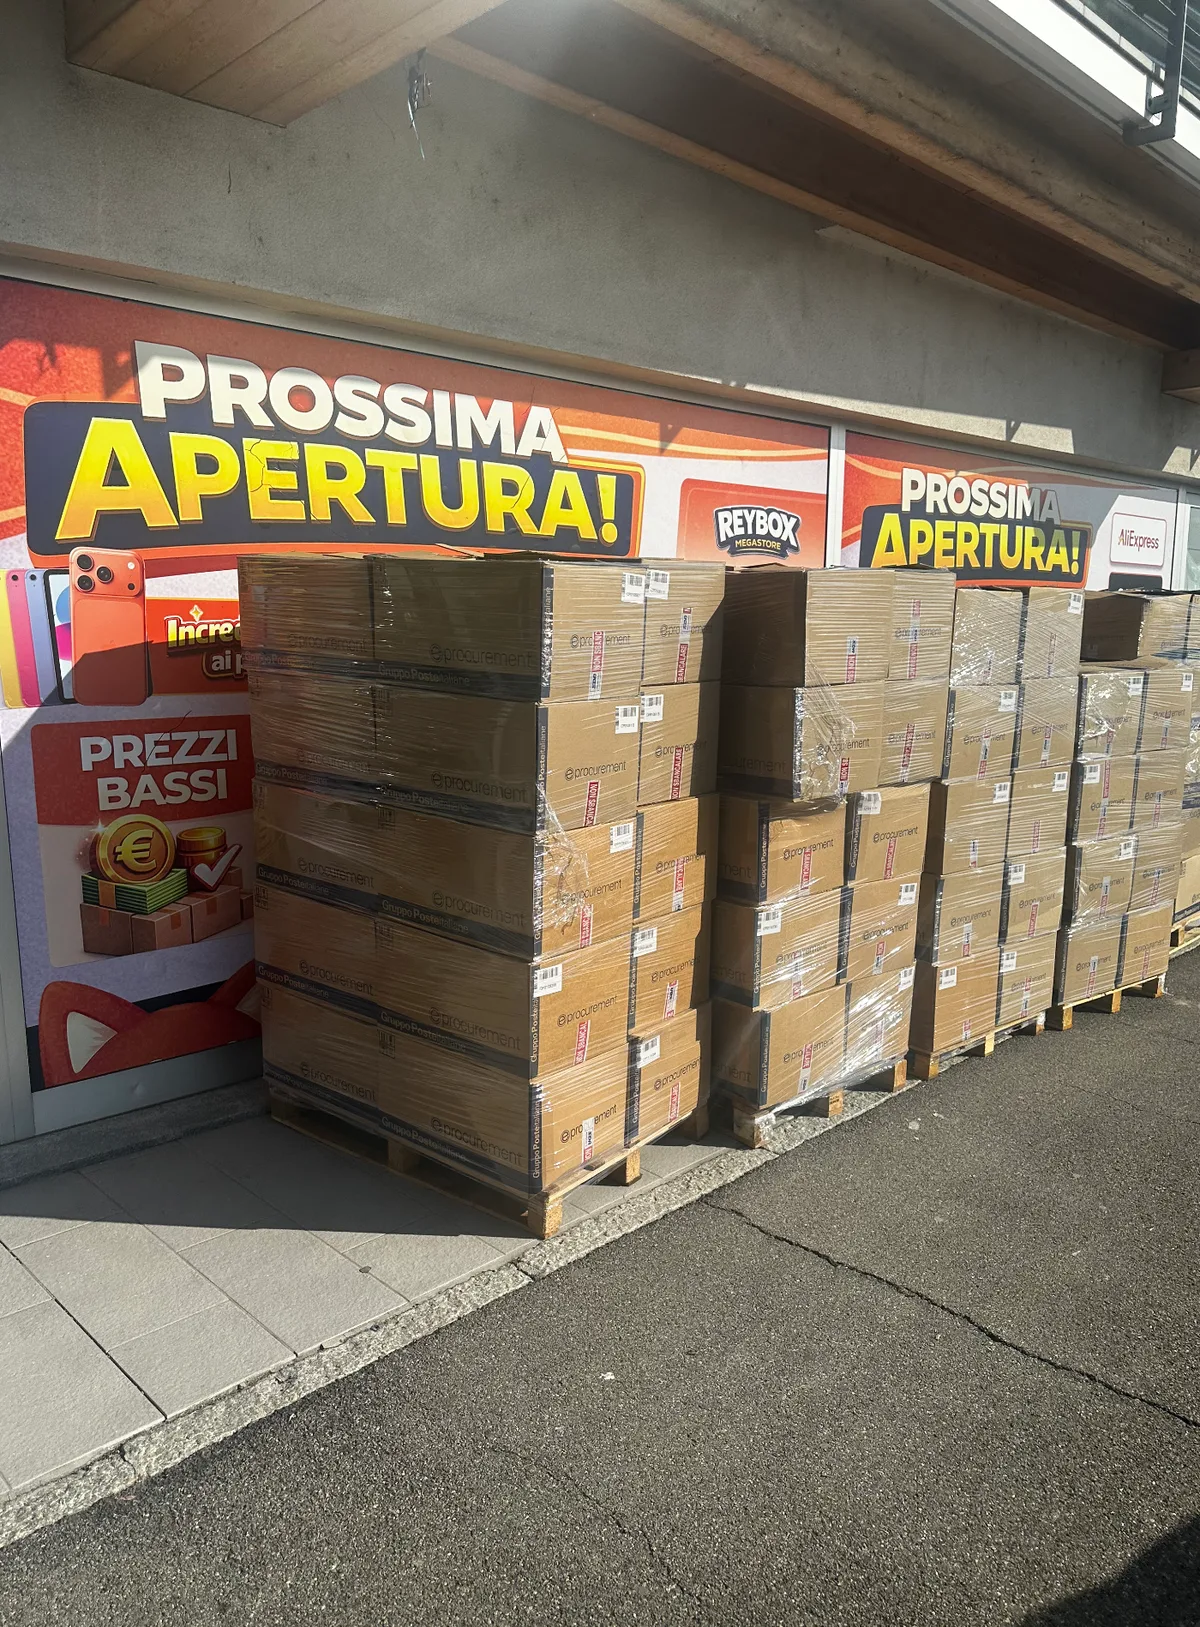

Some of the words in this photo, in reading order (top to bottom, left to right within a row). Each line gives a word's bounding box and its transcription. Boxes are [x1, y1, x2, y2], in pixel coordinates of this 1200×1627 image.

[134, 340, 569, 463] PROSSIMA
[55, 417, 618, 543] APERTURA!
[901, 468, 1061, 525] PROSSIMA
[717, 509, 798, 547] REYBOX
[1118, 529, 1160, 552] AliExpress
[735, 538, 782, 550] MEGASTORE
[871, 513, 1081, 575] APERTURA!
[211, 652, 231, 671] ai
[429, 643, 532, 668] eprocurement
[379, 664, 410, 680] Gruppo
[80, 730, 238, 771] PREZZI
[564, 761, 627, 781] eprocurement
[97, 769, 228, 811] BASSI
[431, 771, 528, 803] eprocurement
[588, 783, 598, 798] NON
[258, 867, 283, 884] Gruppo
[382, 900, 412, 919] Gruppo
[432, 890, 525, 926] eprocurement
[258, 965, 284, 983] Gruppo
[299, 959, 374, 997] eprocurement
[381, 1011, 410, 1031] Gruppo
[557, 996, 618, 1027] eprocurement
[429, 1006, 521, 1051] eprocurement
[531, 1032, 539, 1063] Gruppo
[300, 1061, 377, 1101] eprocurement
[381, 1117, 411, 1138] Gruppo
[431, 1116, 523, 1166] eprocurement
[532, 1149, 541, 1178] Gruppo
